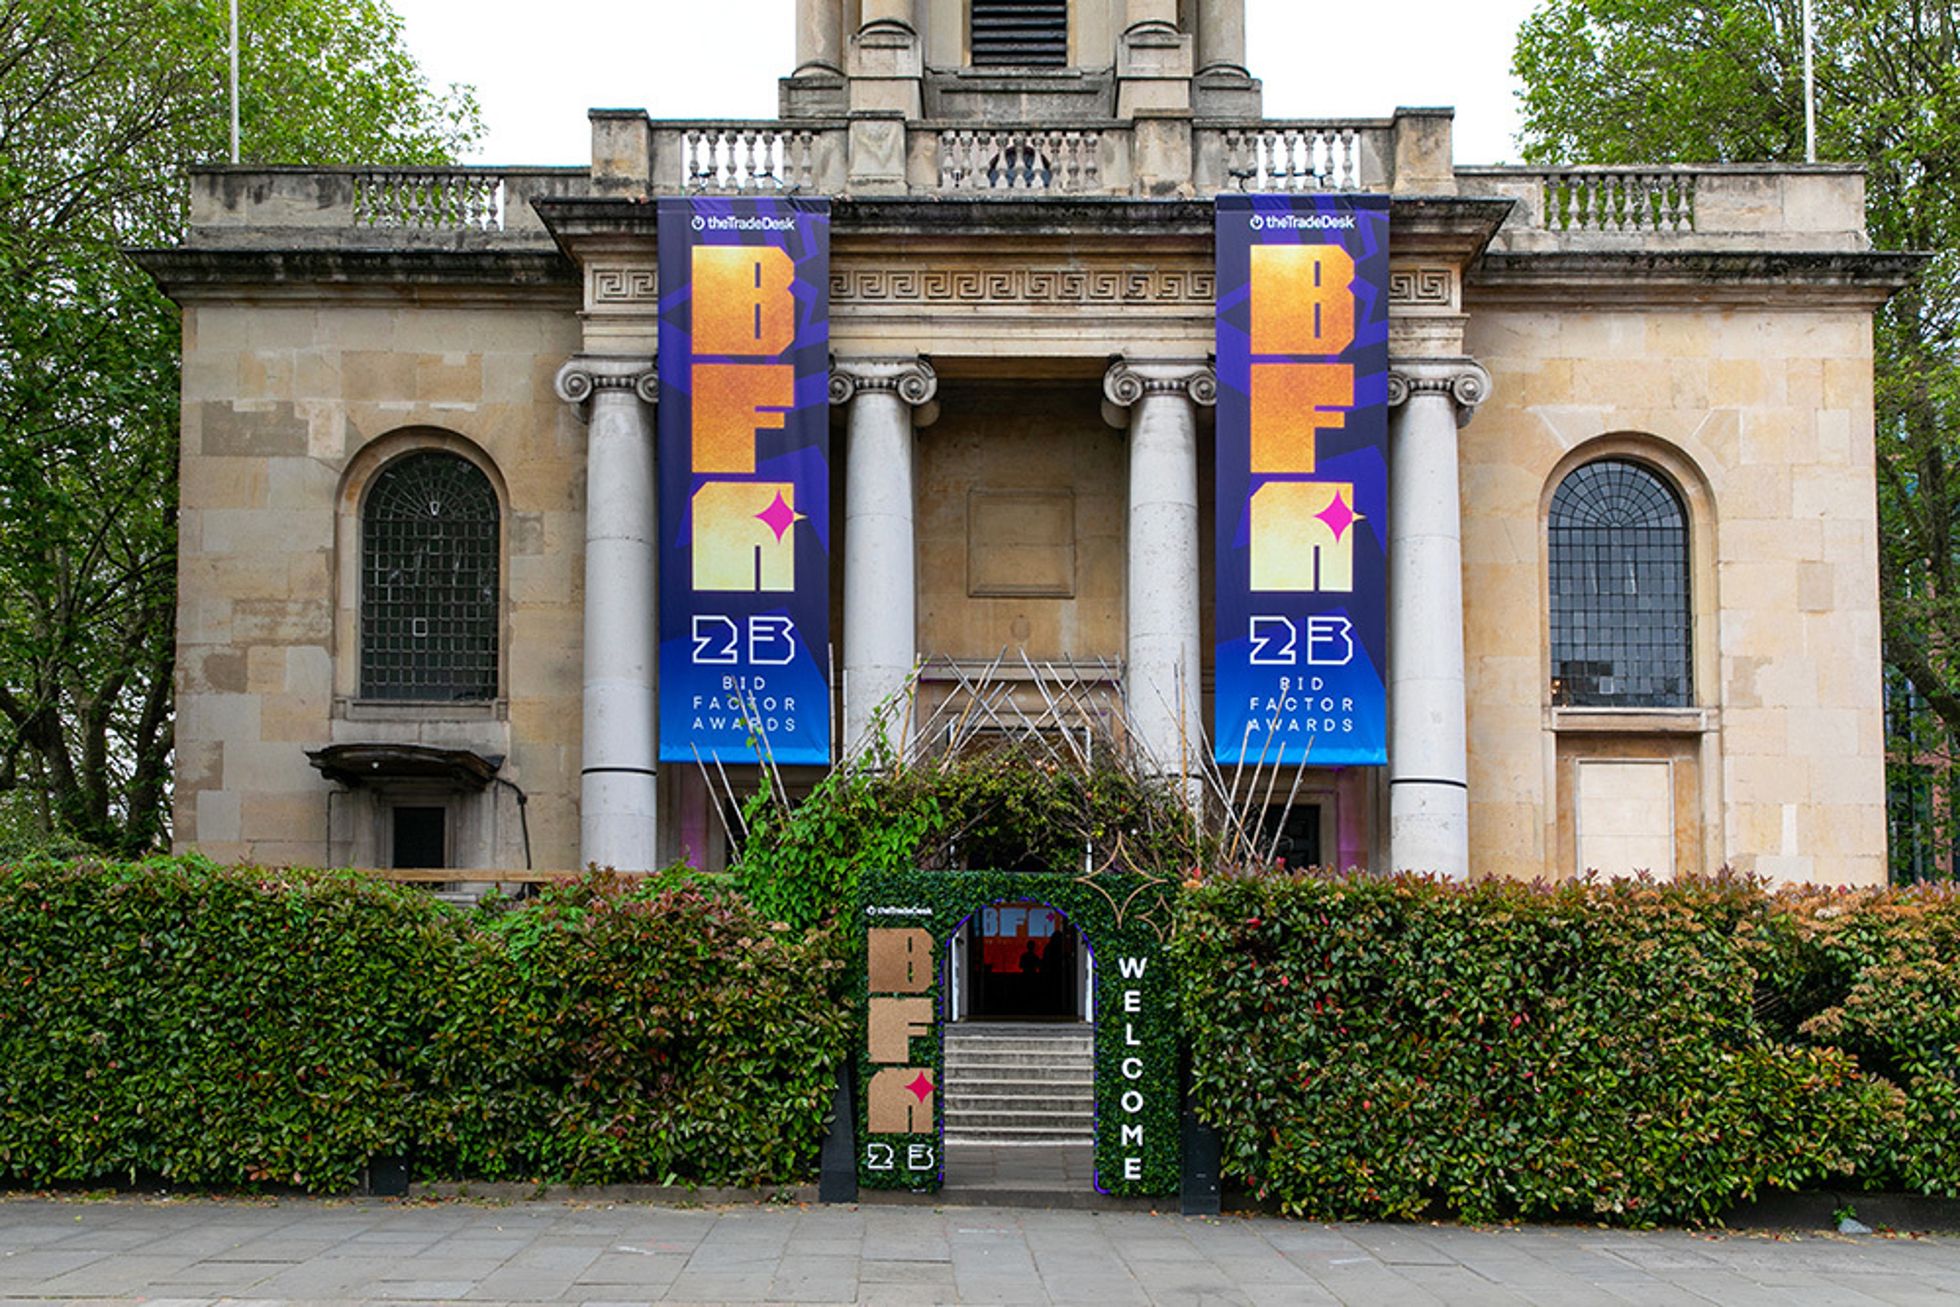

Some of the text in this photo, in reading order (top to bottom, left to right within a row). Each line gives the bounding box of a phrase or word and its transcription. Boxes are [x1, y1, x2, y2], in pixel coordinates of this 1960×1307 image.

[707, 215, 795, 230] theTradeDesk
[1266, 214, 1355, 229] theTradeDesk
[722, 675, 765, 691] BID
[1279, 676, 1324, 691] BID
[1250, 697, 1353, 712] FACTOR
[1250, 718, 1353, 732] AWARDS
[1118, 957, 1147, 1180] WELCOME
